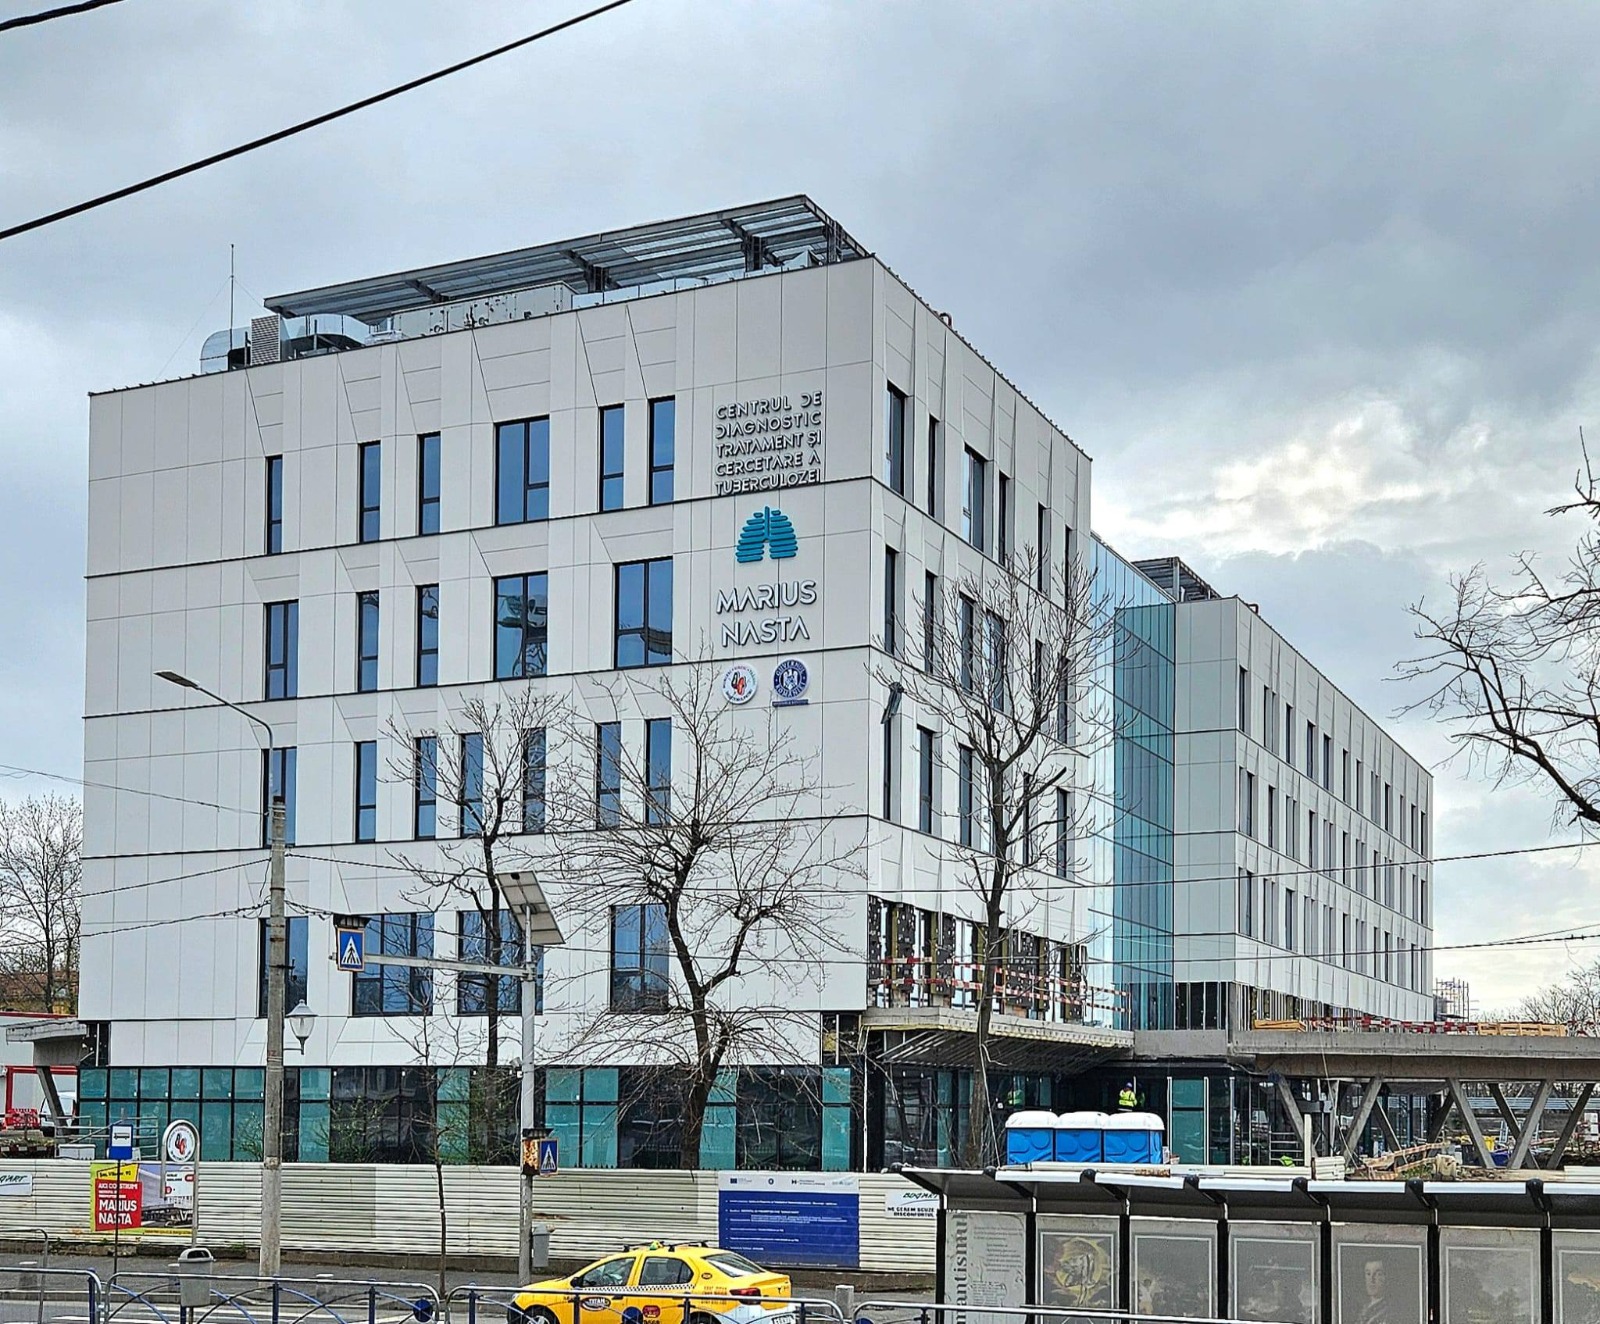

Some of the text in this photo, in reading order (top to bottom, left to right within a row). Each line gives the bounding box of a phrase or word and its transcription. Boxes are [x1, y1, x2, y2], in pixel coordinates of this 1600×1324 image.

[716, 391, 822, 419] CENTRUL DE
[715, 411, 822, 439] DIAGNOSTIC
[716, 433, 804, 458] TRATAMENT
[715, 450, 821, 476] CERCETARE A
[715, 468, 821, 496] TUBERCULOZEI
[716, 580, 817, 615] MARIUS
[722, 616, 810, 647] NASTA
[98, 1212, 133, 1225] NASTA
